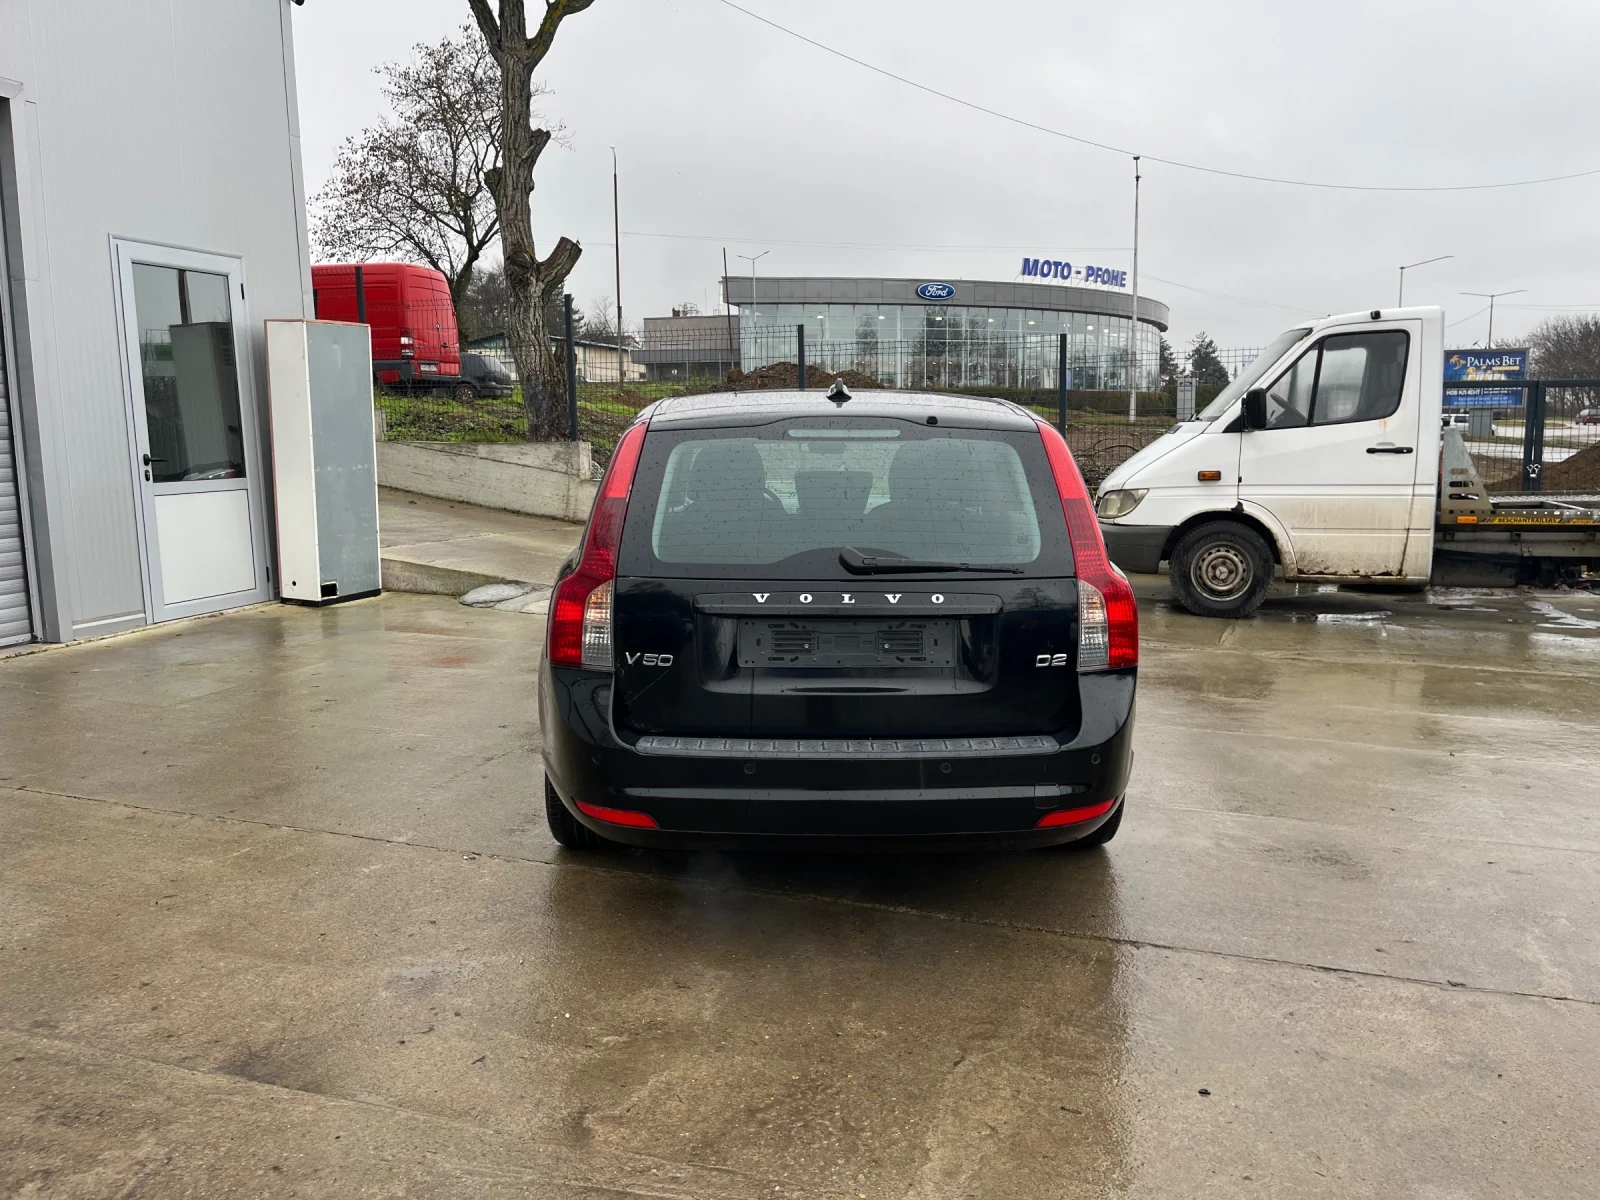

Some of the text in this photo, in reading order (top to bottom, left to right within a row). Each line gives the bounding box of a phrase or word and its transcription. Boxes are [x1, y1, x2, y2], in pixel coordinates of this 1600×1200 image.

[1021, 257, 1072, 280] MOTO
[1084, 265, 1127, 287] PFOHE
[925, 284, 949, 297] Ford
[752, 593, 945, 604] VOLVO
[625, 651, 674, 667] V50
[1035, 653, 1067, 667] D2
